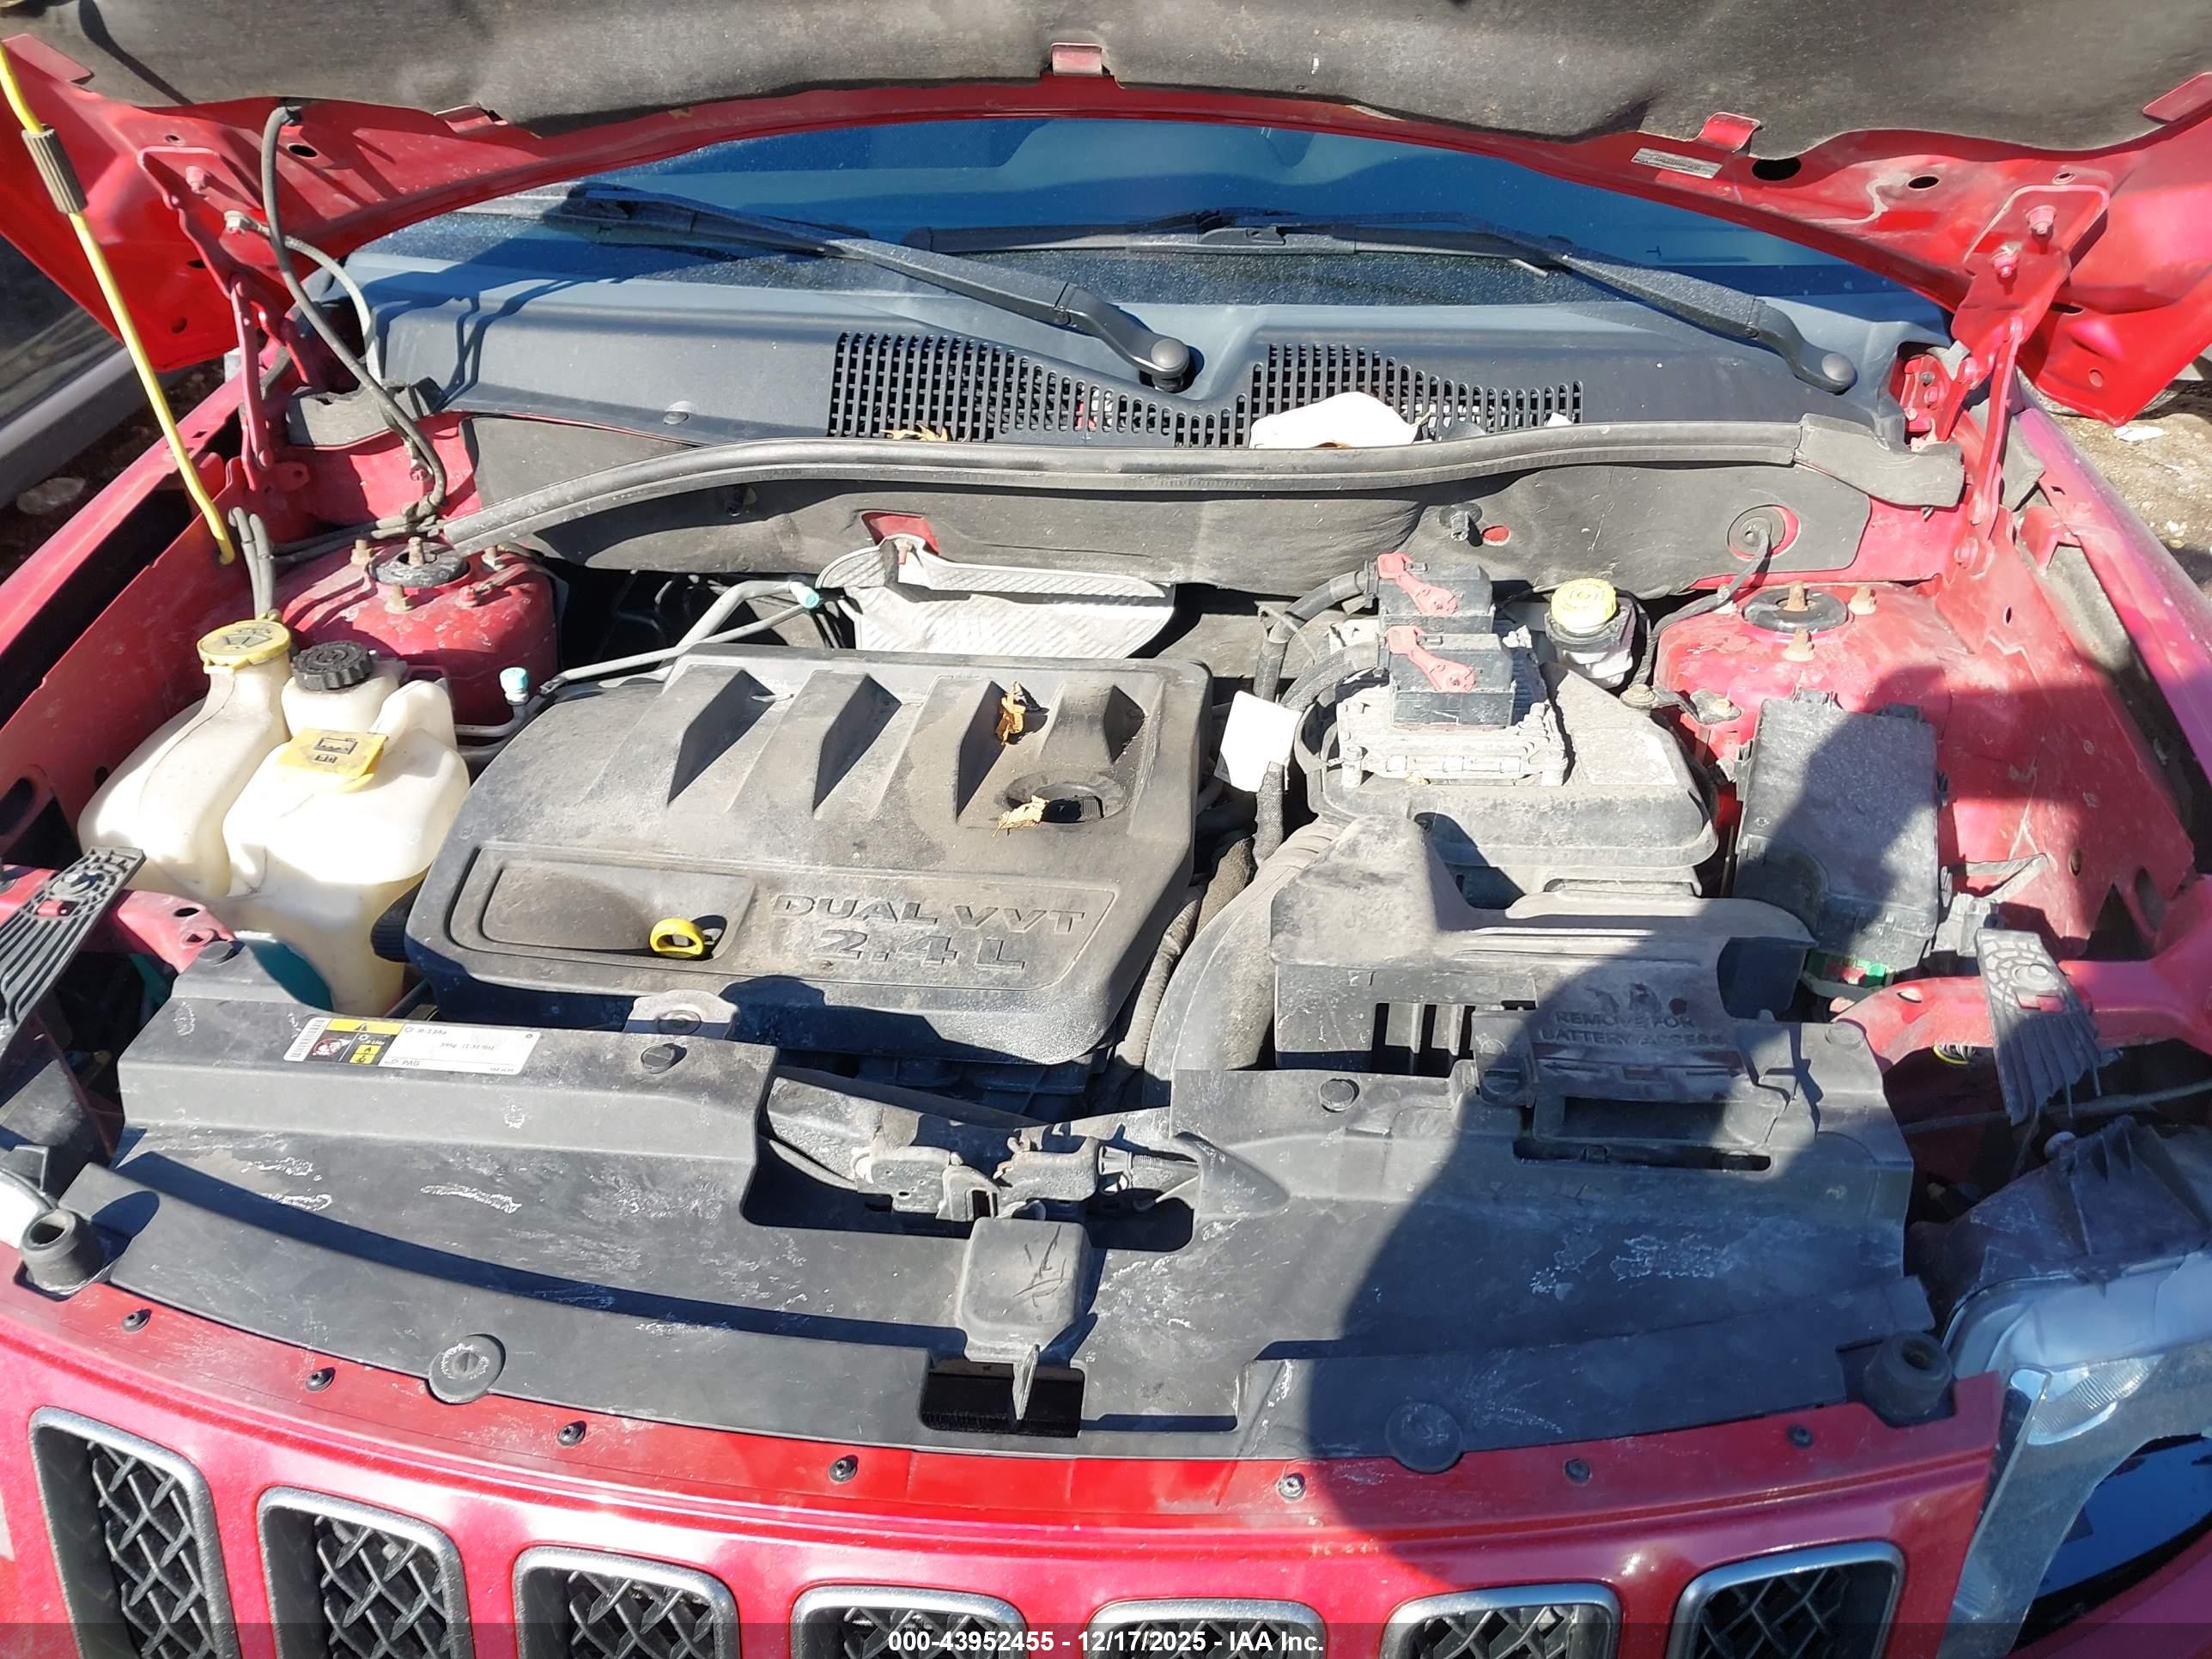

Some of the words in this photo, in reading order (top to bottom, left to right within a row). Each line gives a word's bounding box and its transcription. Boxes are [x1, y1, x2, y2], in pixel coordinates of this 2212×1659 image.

[772, 894, 938, 925] DUAL
[954, 905, 1085, 934] VVT
[1554, 1011, 1649, 1030] REMOVE
[1652, 1015, 1695, 1029] FOR
[1539, 1029, 1629, 1045] BATTERY
[1639, 1034, 1725, 1046] ACCESS
